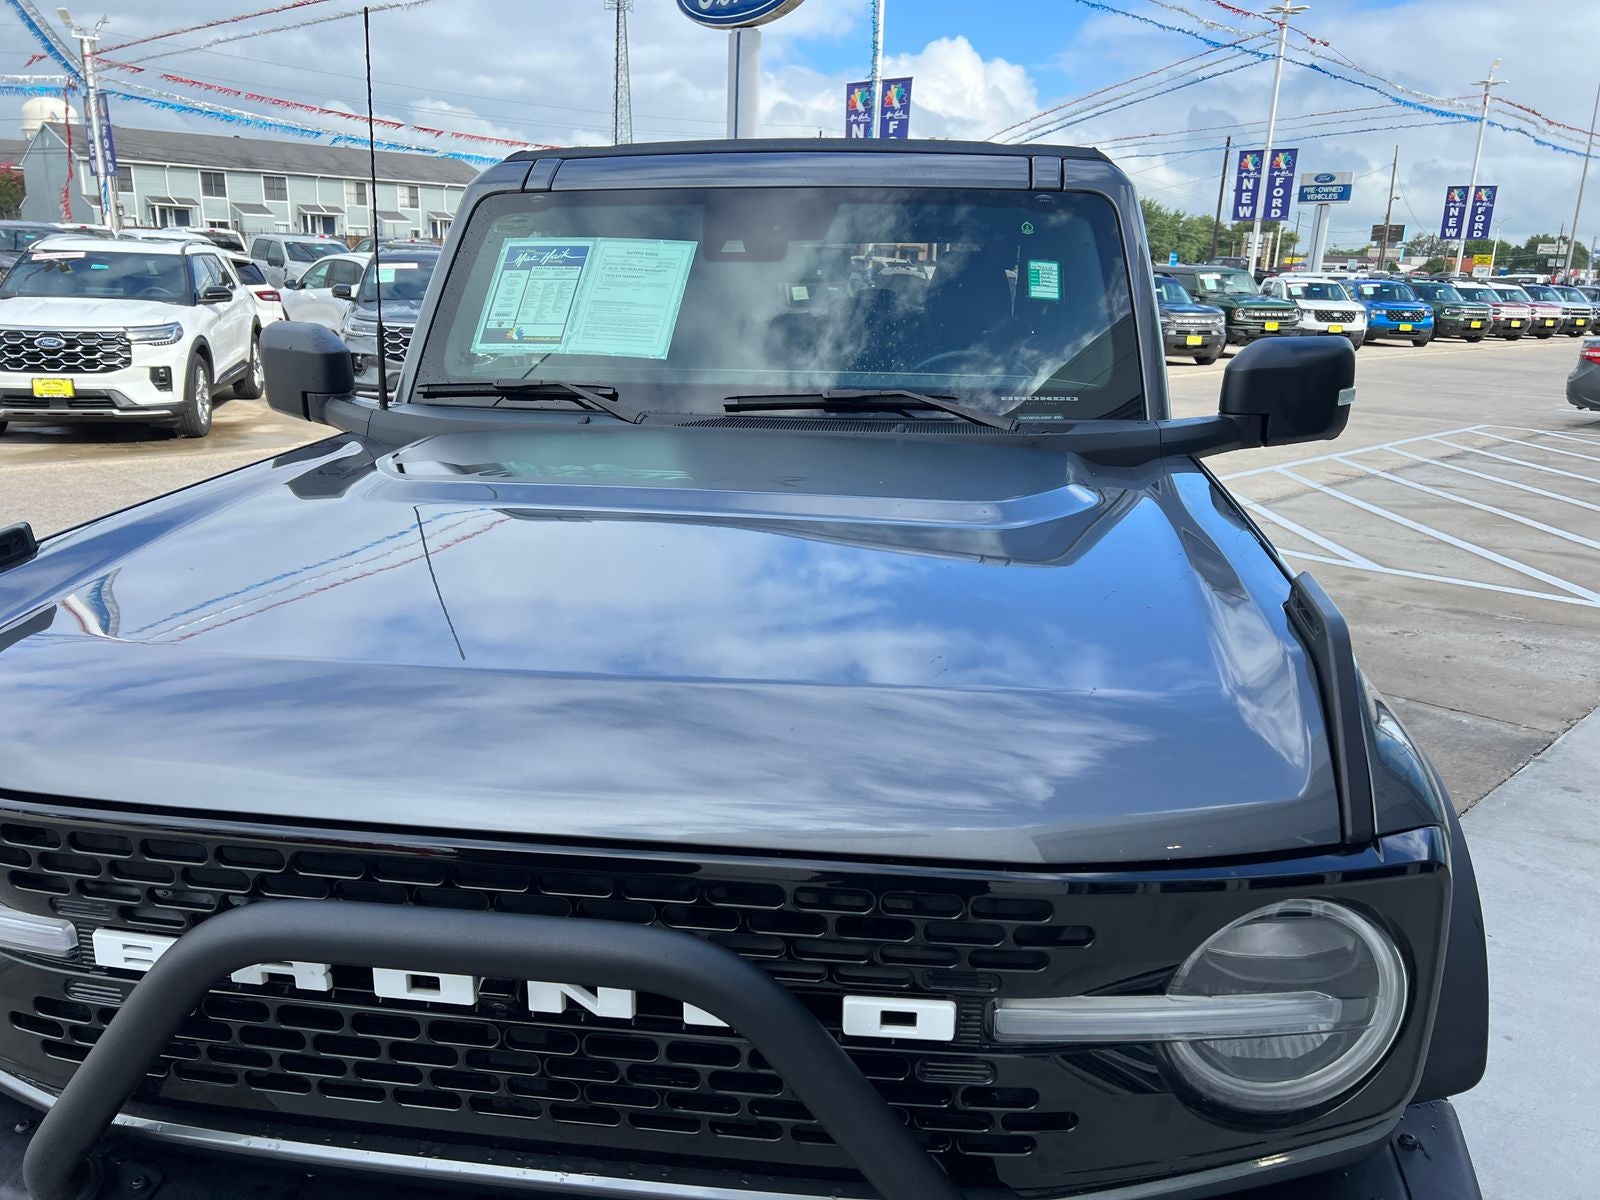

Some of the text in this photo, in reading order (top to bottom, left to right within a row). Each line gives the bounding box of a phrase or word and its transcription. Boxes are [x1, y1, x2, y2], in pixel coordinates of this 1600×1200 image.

[102, 126, 114, 172] FORD
[1238, 178, 1254, 218] NEW
[1270, 177, 1285, 218] FORD
[1445, 207, 1460, 237] NEW
[1472, 206, 1486, 238] FORD
[92, 928, 957, 1041] BRONO
